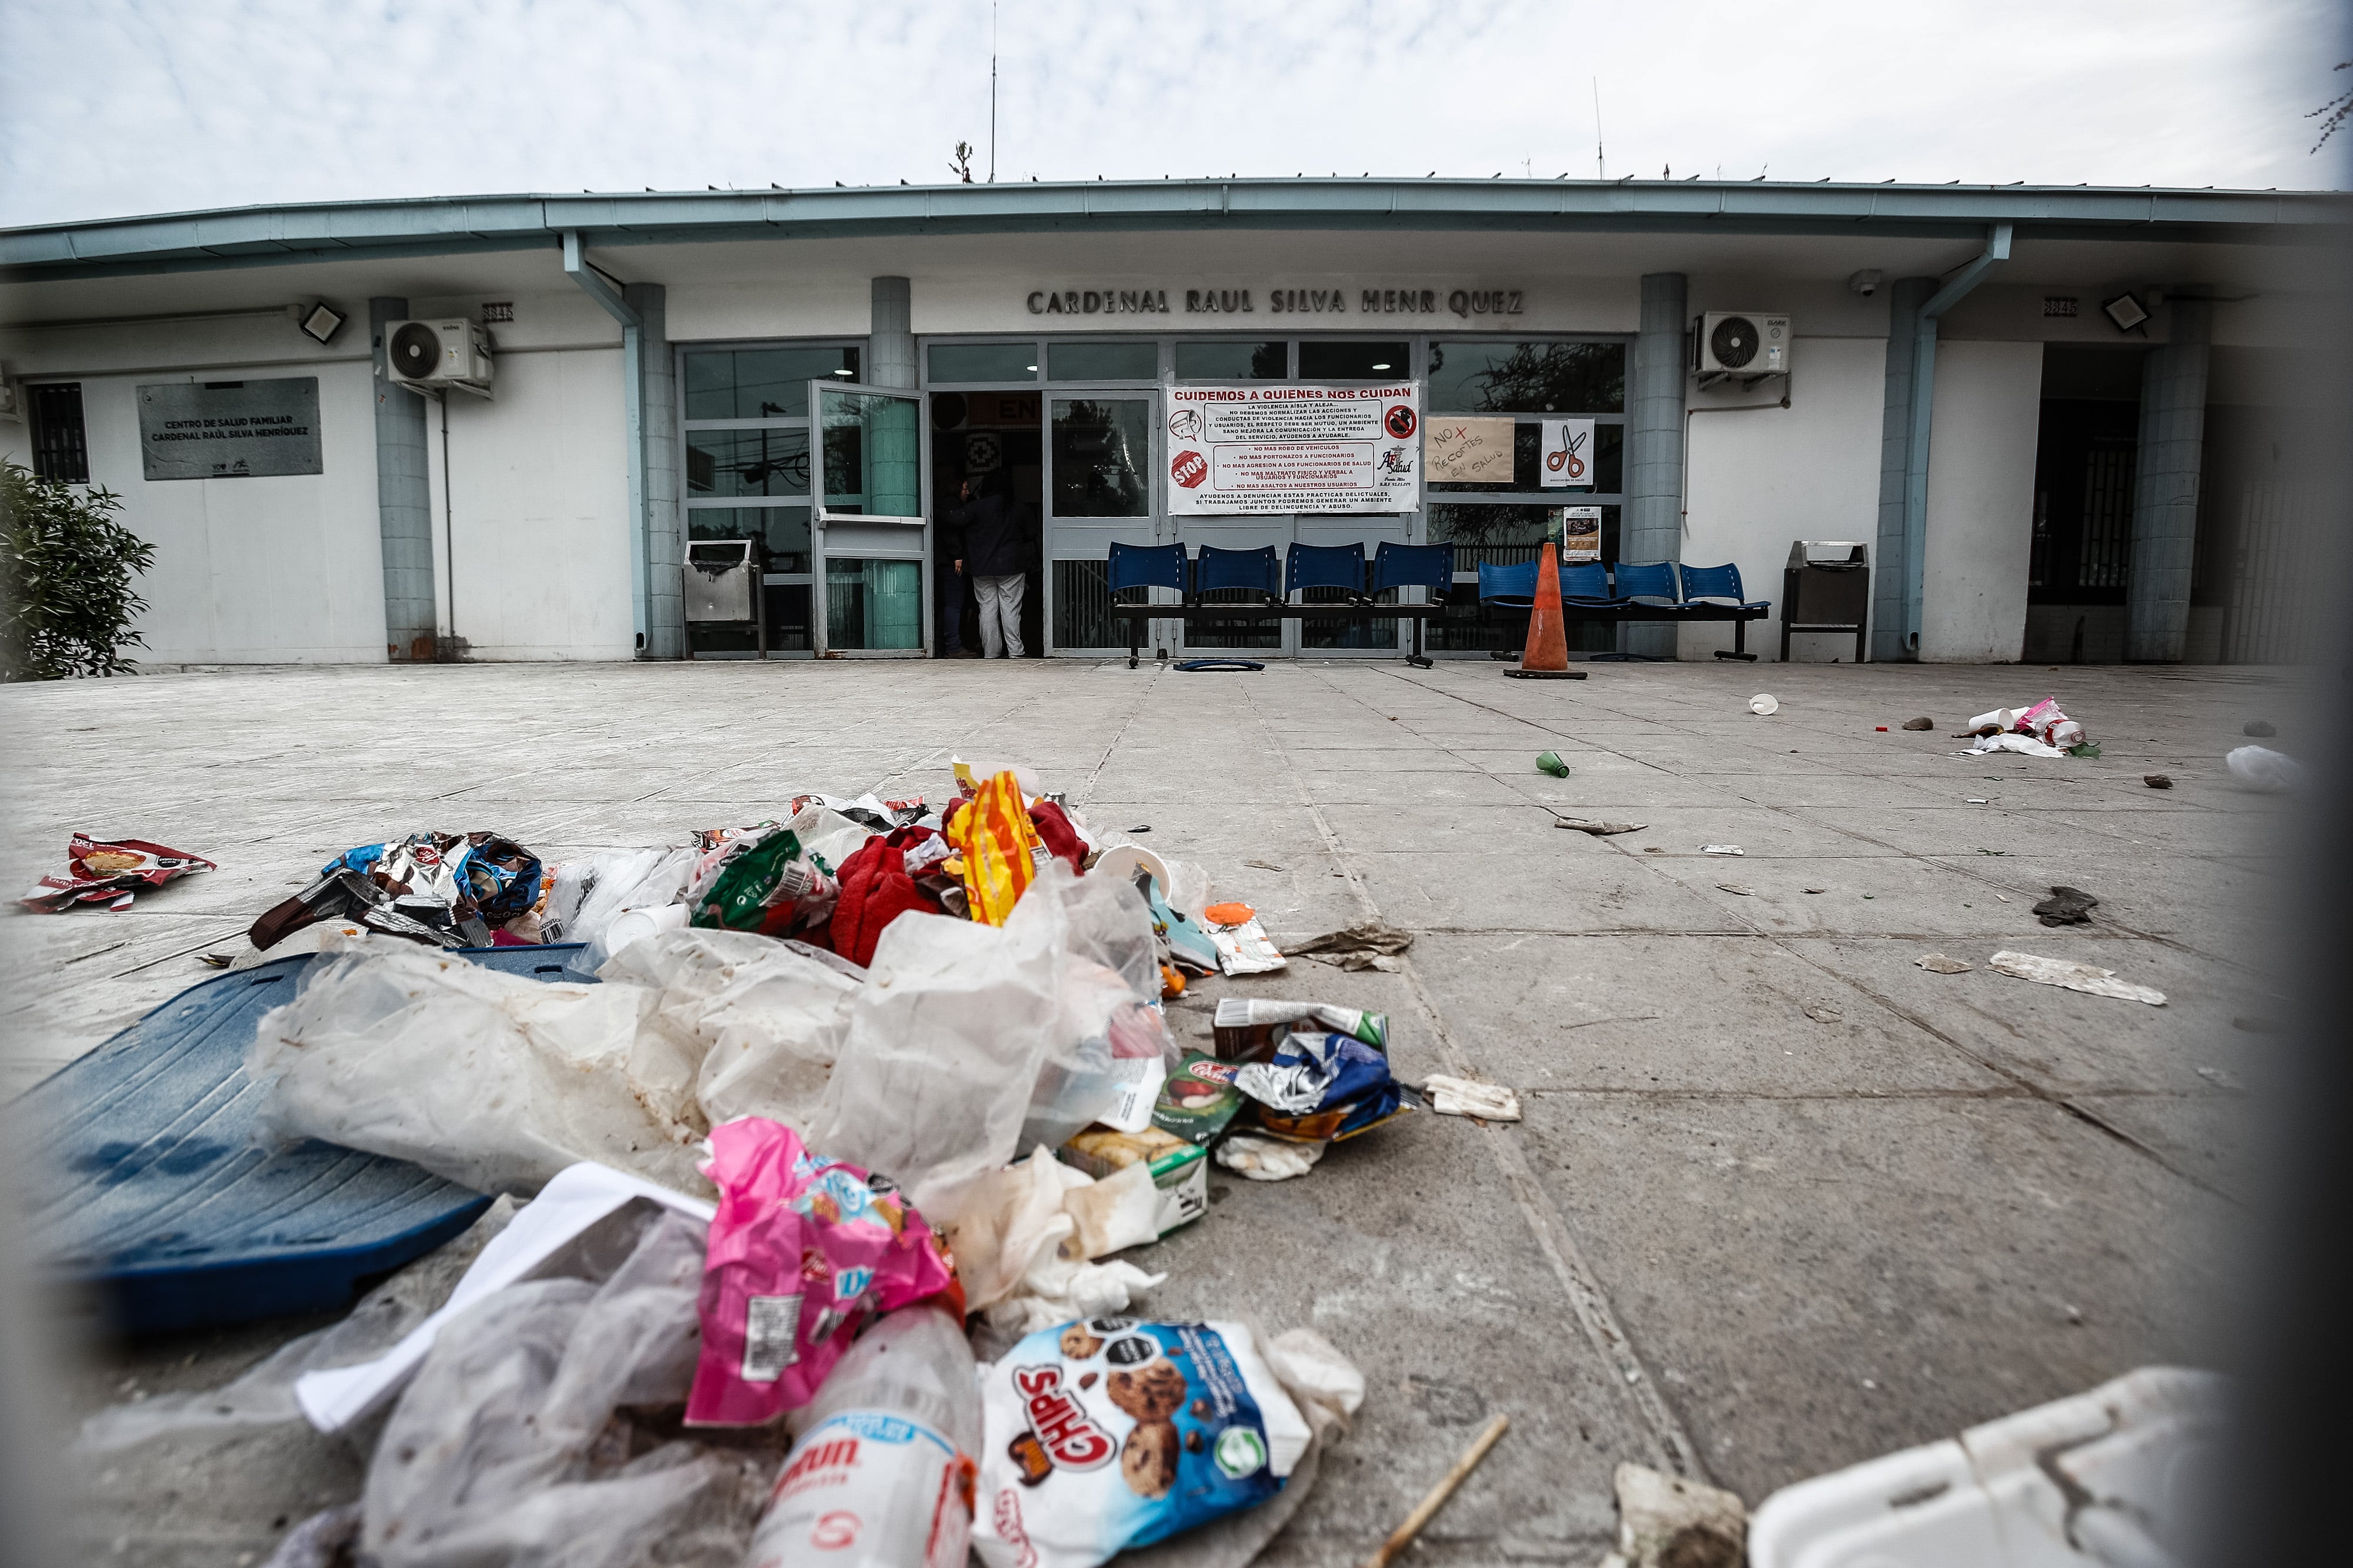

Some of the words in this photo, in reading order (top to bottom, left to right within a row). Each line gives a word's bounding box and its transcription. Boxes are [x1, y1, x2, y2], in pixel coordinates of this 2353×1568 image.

[1026, 291, 1169, 313] CARDENAL
[1186, 290, 1254, 312] RAUL
[1271, 289, 1345, 312] SILVA
[2044, 301, 2077, 313] 3345
[1175, 391, 1245, 401] CUIDEMOS
[1249, 391, 1259, 400] A
[1263, 389, 1323, 400] QUIENES
[1328, 391, 1355, 399] NOS
[1359, 388, 1411, 398] CUIDAN
[165, 419, 202, 429] CENTRO
[204, 419, 216, 428] DE
[218, 418, 248, 426] SALUD
[250, 415, 293, 425] FAMILIAR
[152, 433, 201, 441] CARDENAL
[229, 430, 254, 438] SILVA
[1434, 429, 1452, 448] NO
[1174, 456, 1203, 483] STOP
[1451, 463, 1465, 477] EN
[1472, 451, 1503, 472] SALUD
[1019, 1369, 1109, 1464] CHIPS
